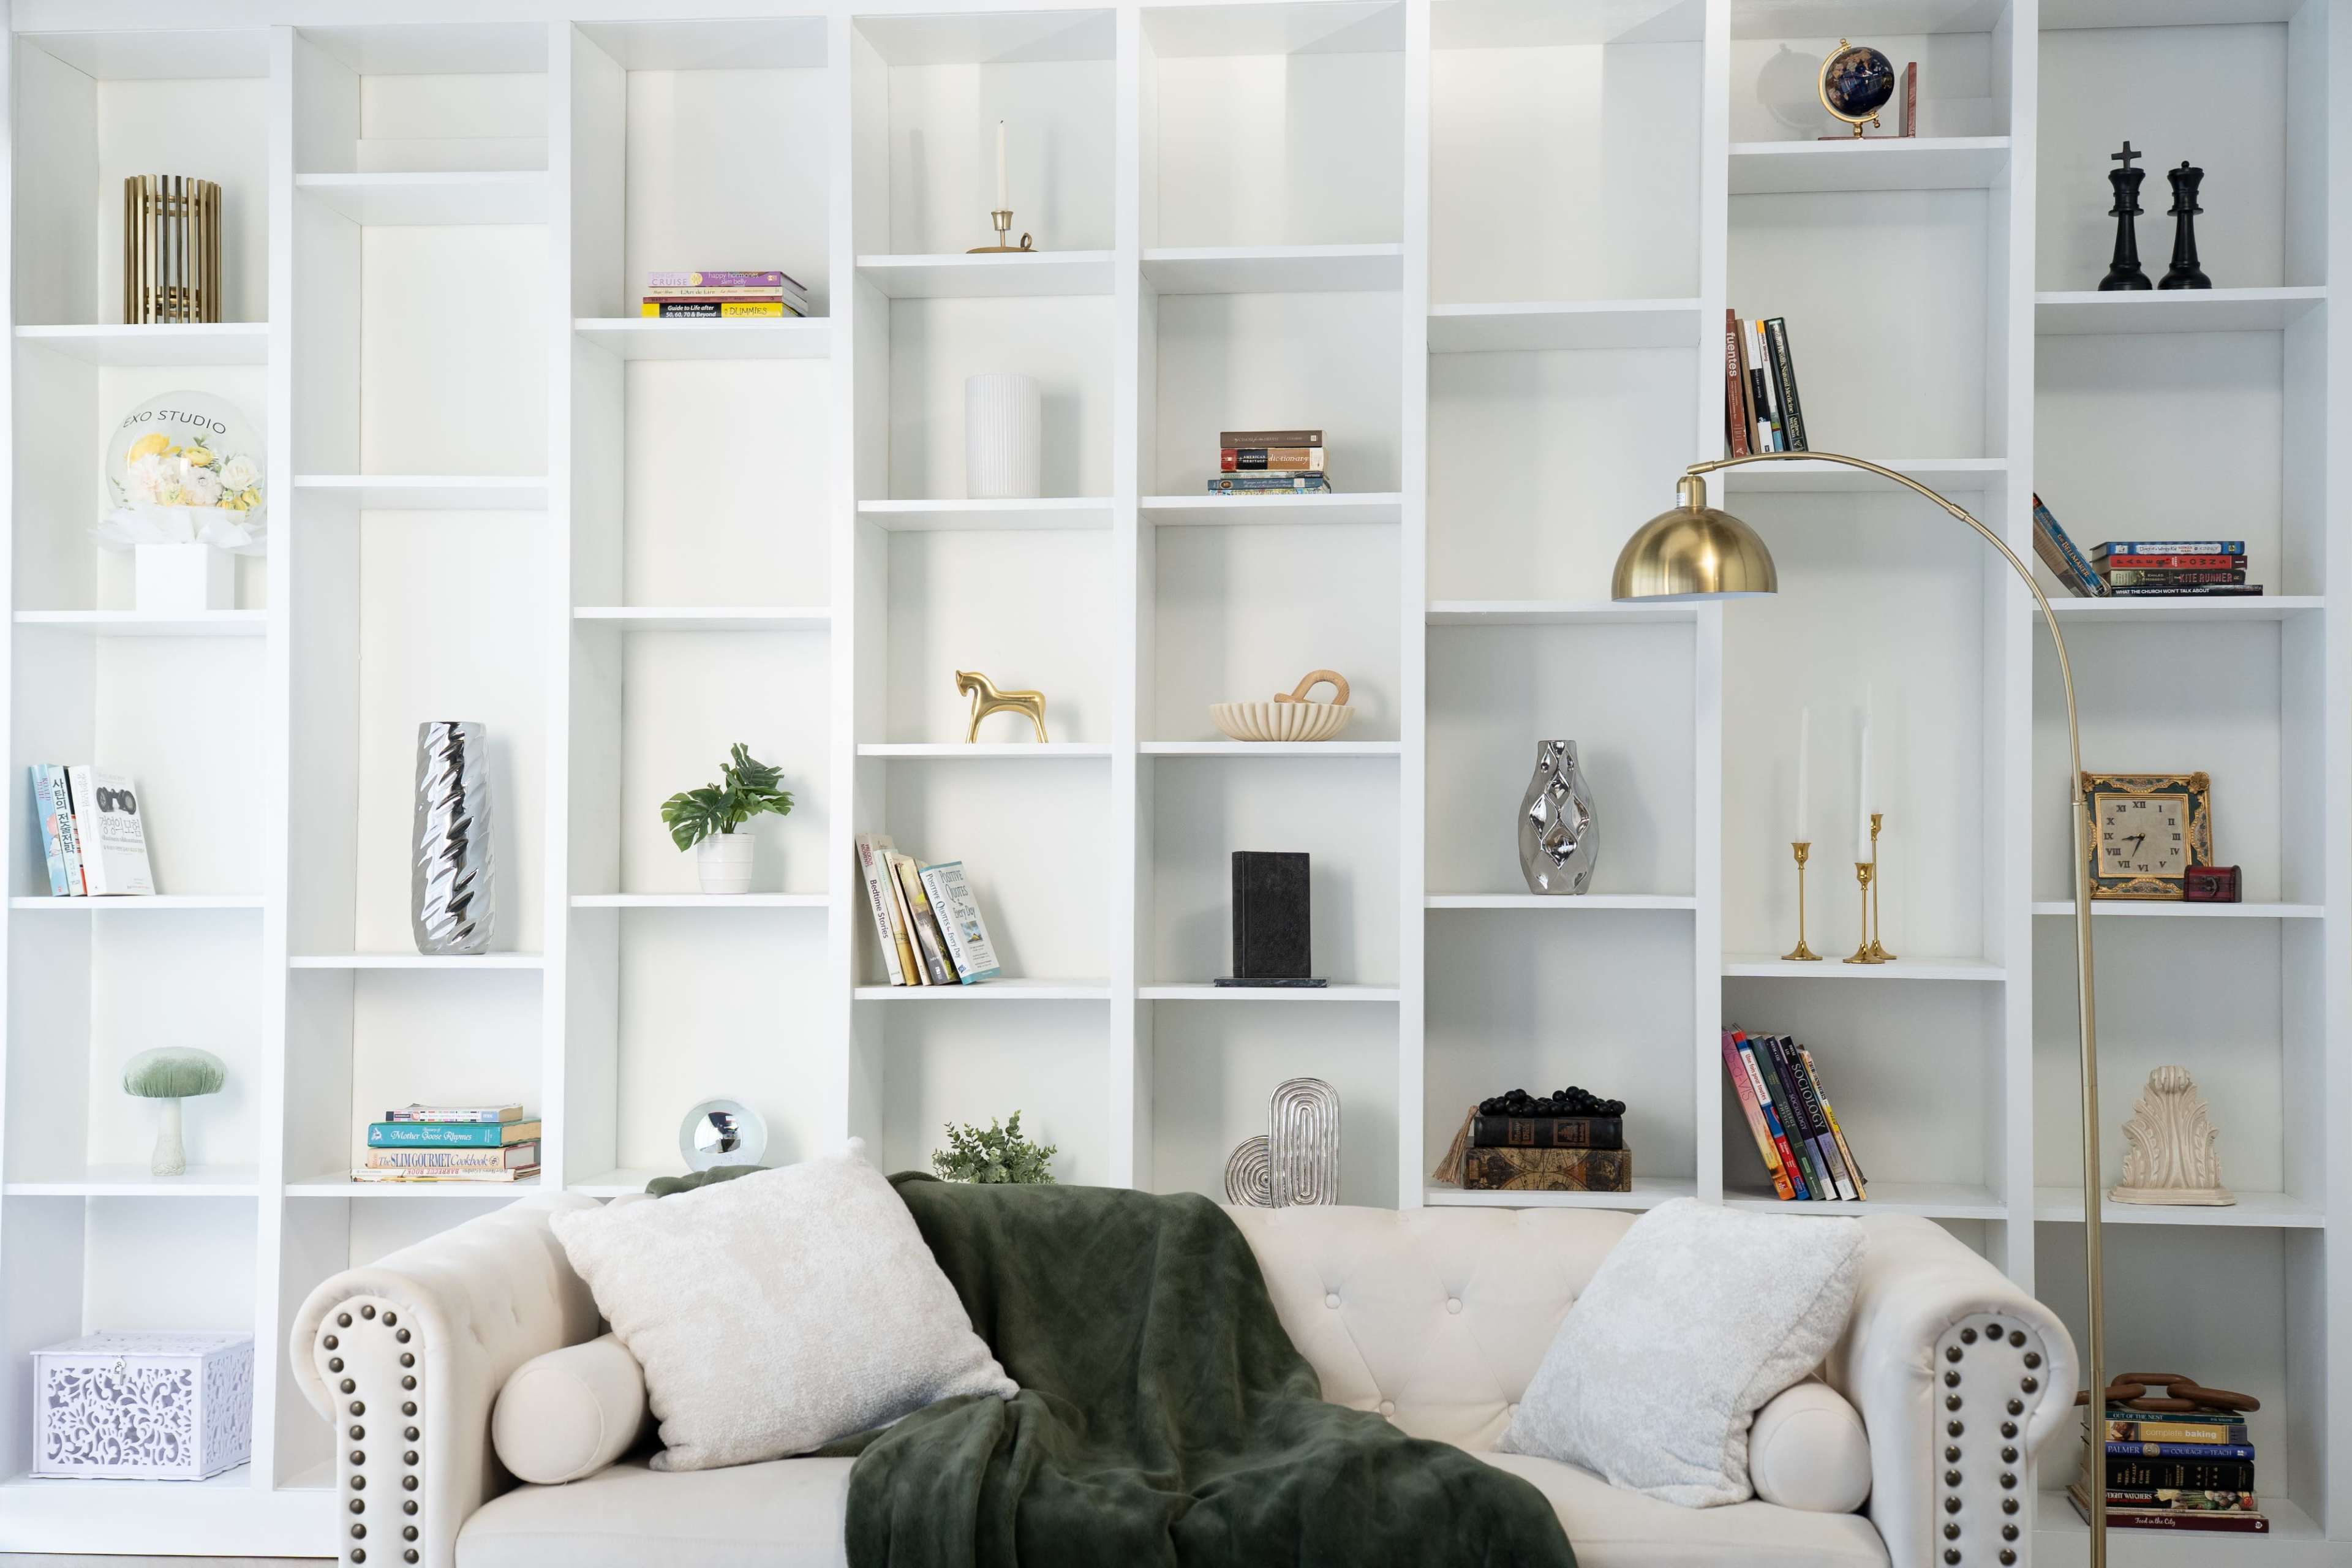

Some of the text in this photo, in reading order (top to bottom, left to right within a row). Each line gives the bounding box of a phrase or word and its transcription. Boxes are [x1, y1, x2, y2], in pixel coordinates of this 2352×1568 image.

[729, 307, 767, 315] DUMMIES
[1726, 332, 1737, 377] fuentes
[1781, 367, 1790, 387] Natural
[1785, 387, 1795, 413] Medicine
[123, 410, 226, 434] EXO STUDIO
[2062, 540, 2090, 578] BELLMAKER
[2180, 573, 2197, 582] KITE
[2199, 573, 2233, 582] RUNNER
[53, 778, 74, 854] 사탄의 전술전략
[99, 815, 124, 836] 경영의
[938, 870, 963, 883] POSITIVE
[925, 873, 940, 900] POSITIVE
[935, 901, 950, 927] QUOTES
[945, 884, 968, 903] QUOTES
[870, 879, 889, 938] Bedtime Stories
[1749, 1064, 1757, 1072] fois
[1752, 1073, 1762, 1085] pour
[1757, 1085, 1767, 1101] toutes
[1791, 1063, 1826, 1131] SOCIOLOGY
[1777, 1104, 1791, 1129] PHYSICS
[1783, 1101, 1796, 1127] COLLEGE
[1789, 1093, 1807, 1131] SOCIOLOGY
[391, 1131, 472, 1140] Mother Goose Rhymes
[379, 1153, 488, 1167] The SLIM GOURMET Cookbook
[2146, 1429, 2182, 1439] complete
[2185, 1430, 2217, 1439] baking
[2164, 1517, 2176, 1527] City
